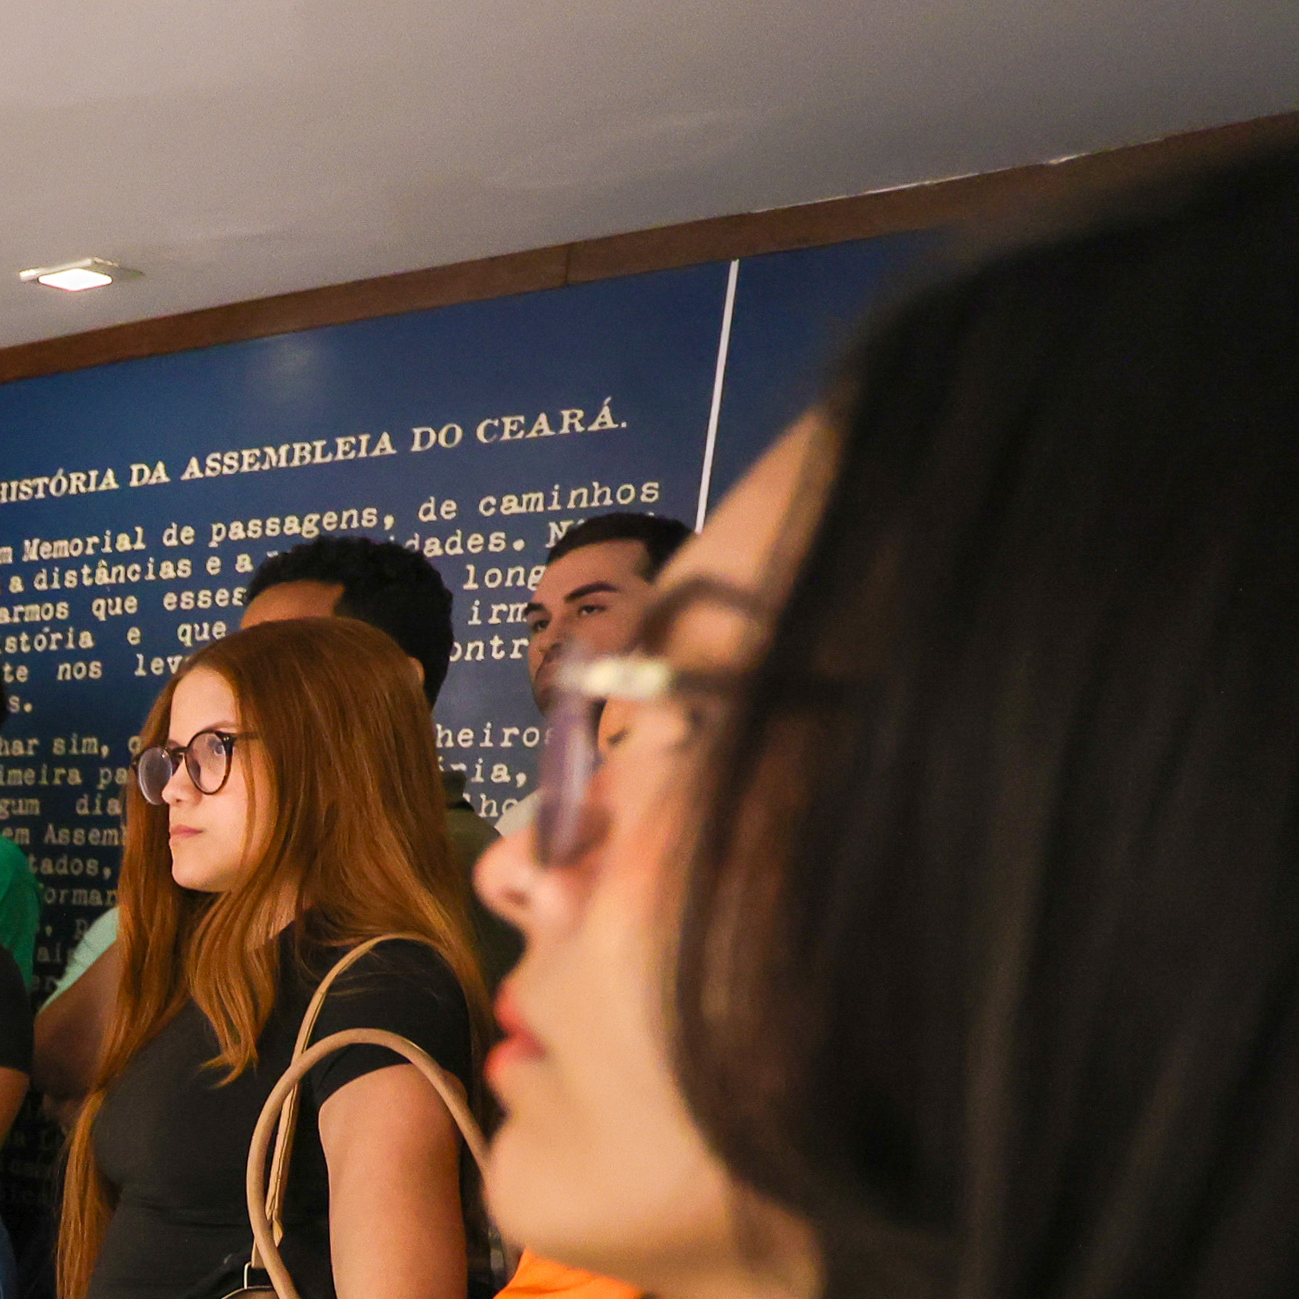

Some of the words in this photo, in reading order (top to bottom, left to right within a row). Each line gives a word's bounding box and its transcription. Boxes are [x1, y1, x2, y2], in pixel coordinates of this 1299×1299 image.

[129, 461, 170, 488] DA
[180, 431, 397, 480] ASSEMBLEIA
[410, 423, 463, 452] DO
[476, 396, 628, 443] CEARÁ.
[22, 527, 146, 562] Memorial
[162, 522, 195, 547] de
[209, 505, 395, 548] passagens,
[418, 496, 457, 522] de
[479, 481, 660, 516] caminhos
[9, 575, 24, 593] a
[33, 557, 192, 592] distâncias
[206, 556, 222, 576] e
[235, 553, 254, 573] a
[92, 594, 138, 622] que
[127, 626, 142, 647] e
[177, 619, 227, 648] que
[57, 659, 103, 681] nos
[53, 732, 110, 759] sim,
